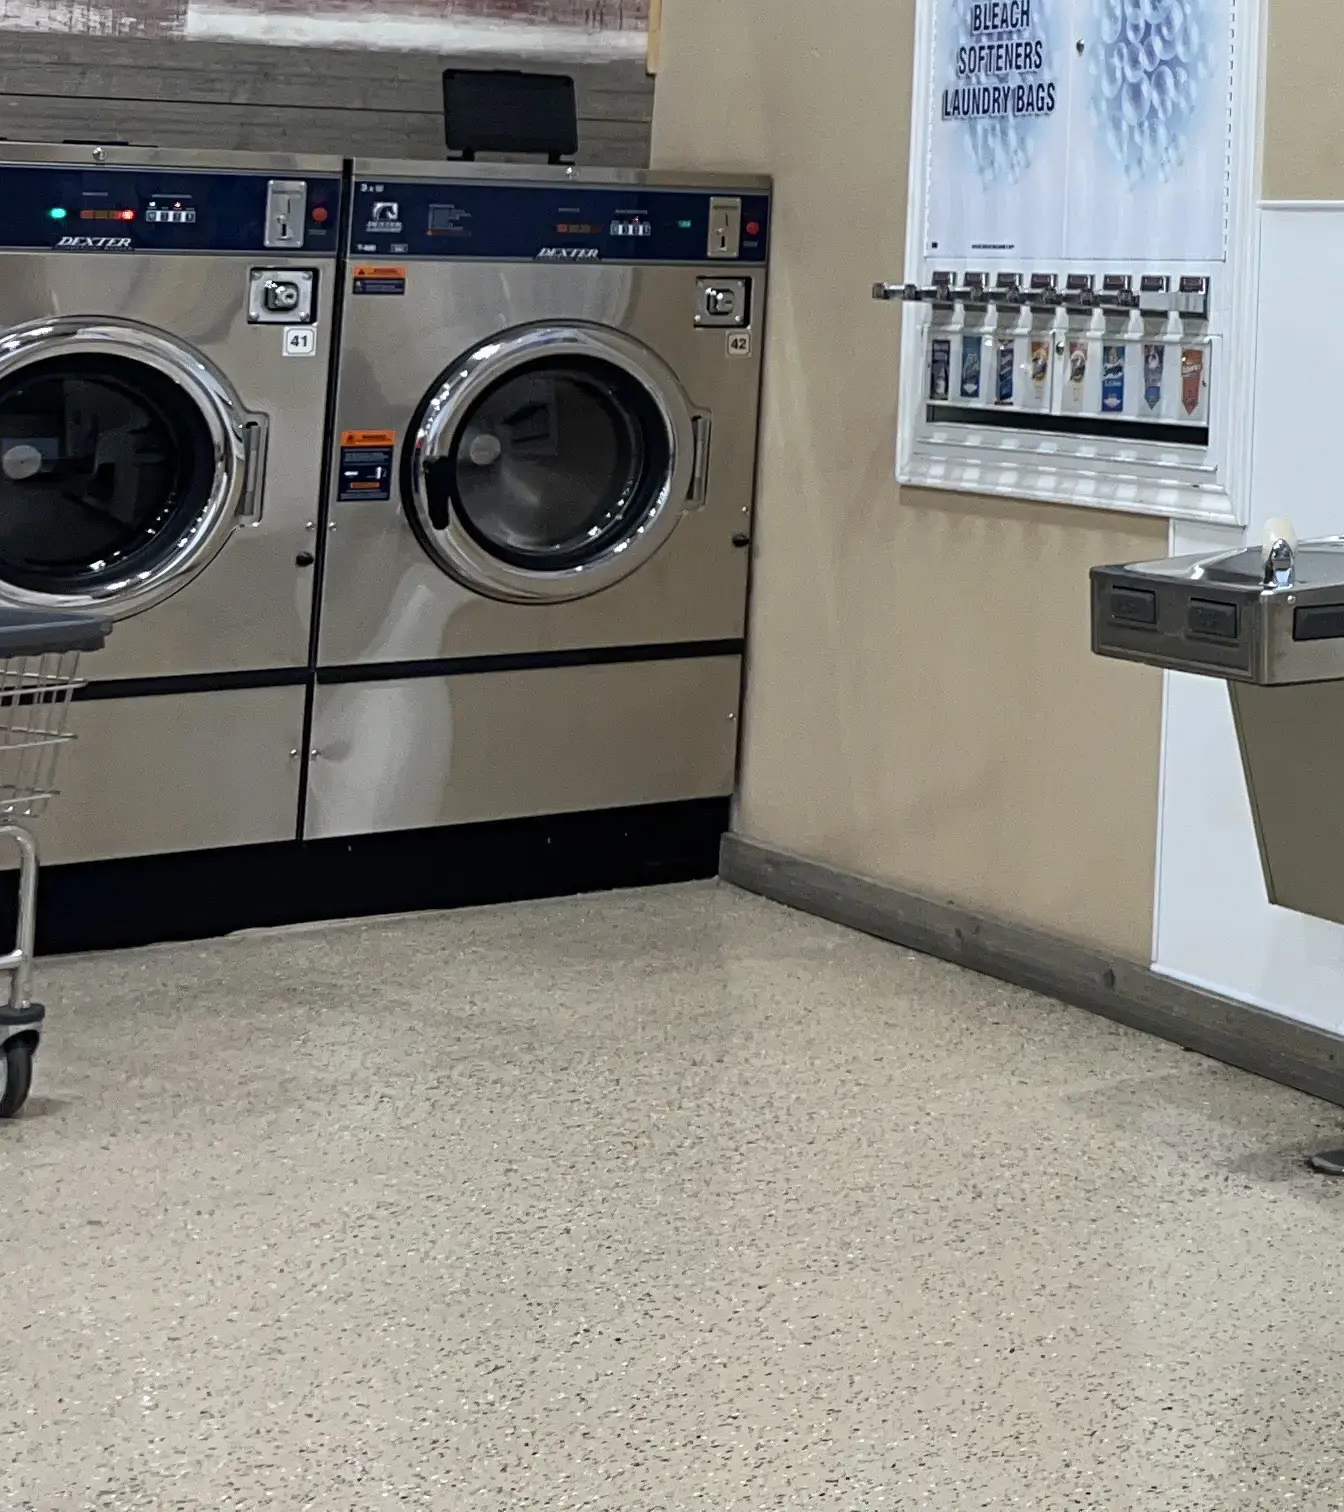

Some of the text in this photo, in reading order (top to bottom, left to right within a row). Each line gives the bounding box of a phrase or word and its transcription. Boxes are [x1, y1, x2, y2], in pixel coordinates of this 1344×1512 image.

[972, 0, 1030, 31] BLEACH
[958, 41, 1043, 75] SOFTENERS
[943, 83, 1056, 117] LAUNDRY BAGS
[57, 236, 132, 247] DEXTER
[537, 247, 599, 257] DEXTER
[290, 335, 308, 346] 41
[730, 338, 747, 350] 42
